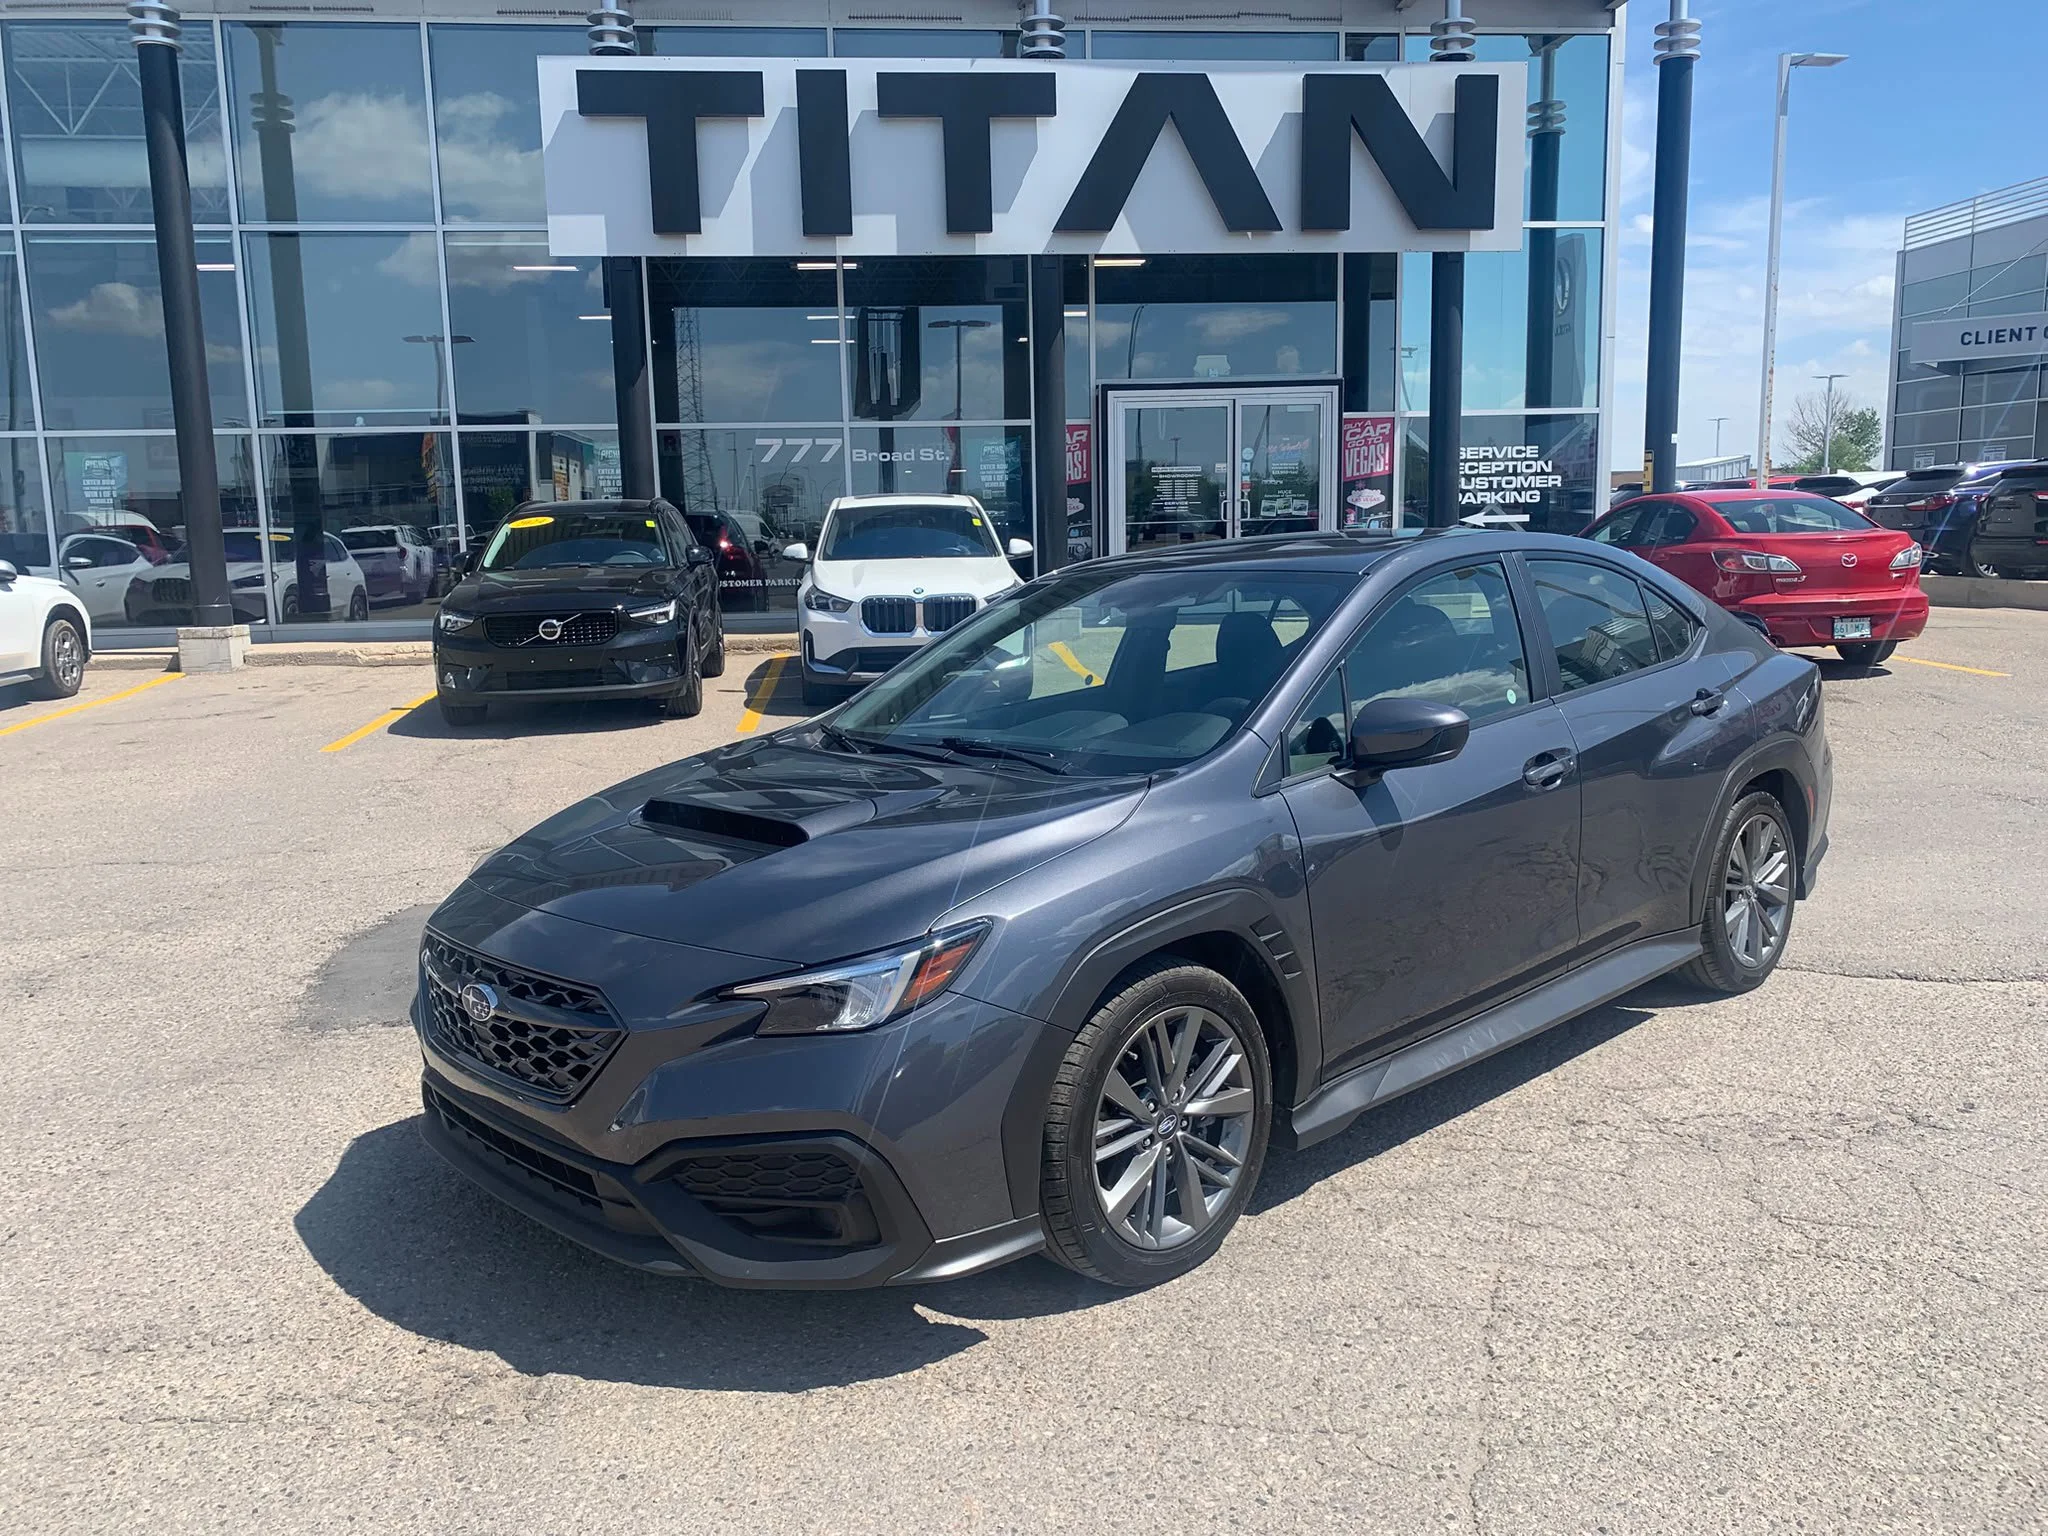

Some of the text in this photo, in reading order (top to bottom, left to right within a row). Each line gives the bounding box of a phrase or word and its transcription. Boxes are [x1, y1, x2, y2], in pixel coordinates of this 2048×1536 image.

[576, 69, 1499, 237] TITAN
[1960, 326, 2037, 346] CLIENT
[1344, 421, 1363, 430] BUY
[1345, 423, 1391, 442] CAR
[1065, 430, 1088, 444] AR
[1348, 436, 1383, 448] GO TO
[755, 438, 950, 463] 777 Broad St.
[1459, 445, 1539, 460] SERVICE
[1066, 449, 1087, 480] AS!
[1345, 442, 1390, 478] VEGAS!
[1459, 460, 1553, 474] CEPTION
[1459, 475, 1562, 490] USTOMER
[1459, 490, 1541, 505] ARKING
[719, 578, 803, 588] STOMER PARKIN
